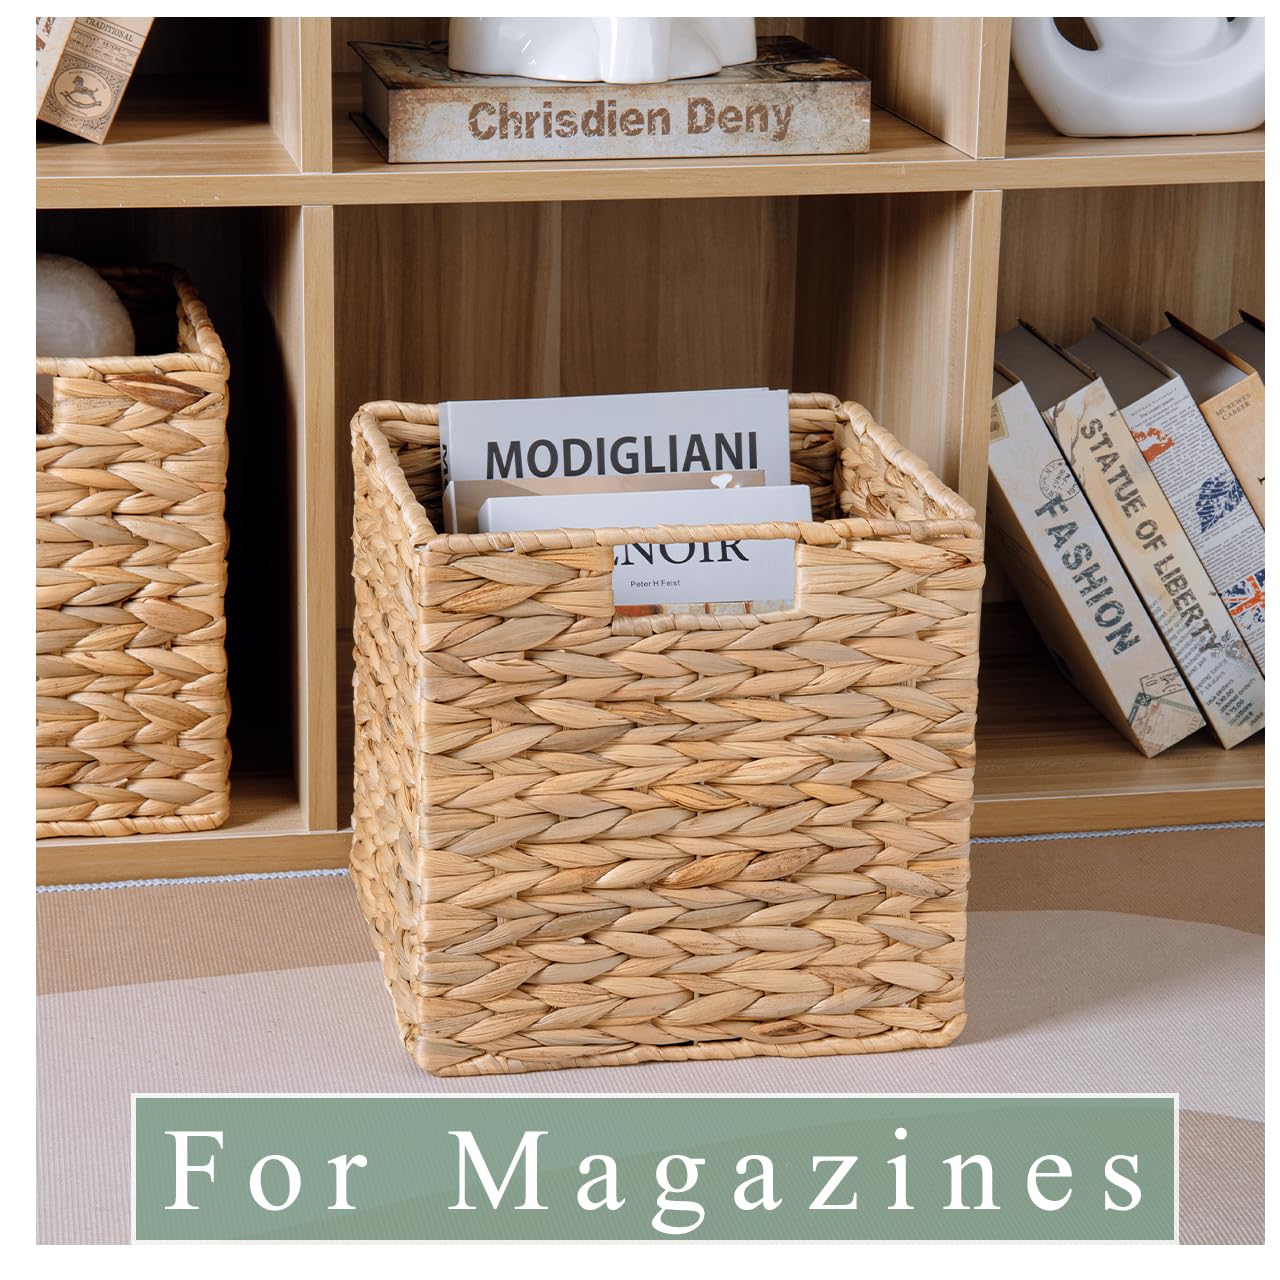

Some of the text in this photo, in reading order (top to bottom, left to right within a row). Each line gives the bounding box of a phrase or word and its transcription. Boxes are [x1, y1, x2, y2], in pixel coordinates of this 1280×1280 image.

[85, 17, 133, 42] TRADITIONAL
[468, 97, 794, 142] Chrisdien Deny
[486, 431, 758, 480] MODIGLIANI
[614, 540, 749, 565] NOIR
[1079, 417, 1146, 519] STATUE
[1135, 521, 1168, 553] OF
[1154, 552, 1220, 654] LIBERTY
[630, 580, 651, 588] Peter
[660, 579, 681, 587] Feist
[1034, 495, 1142, 656] FASHION
